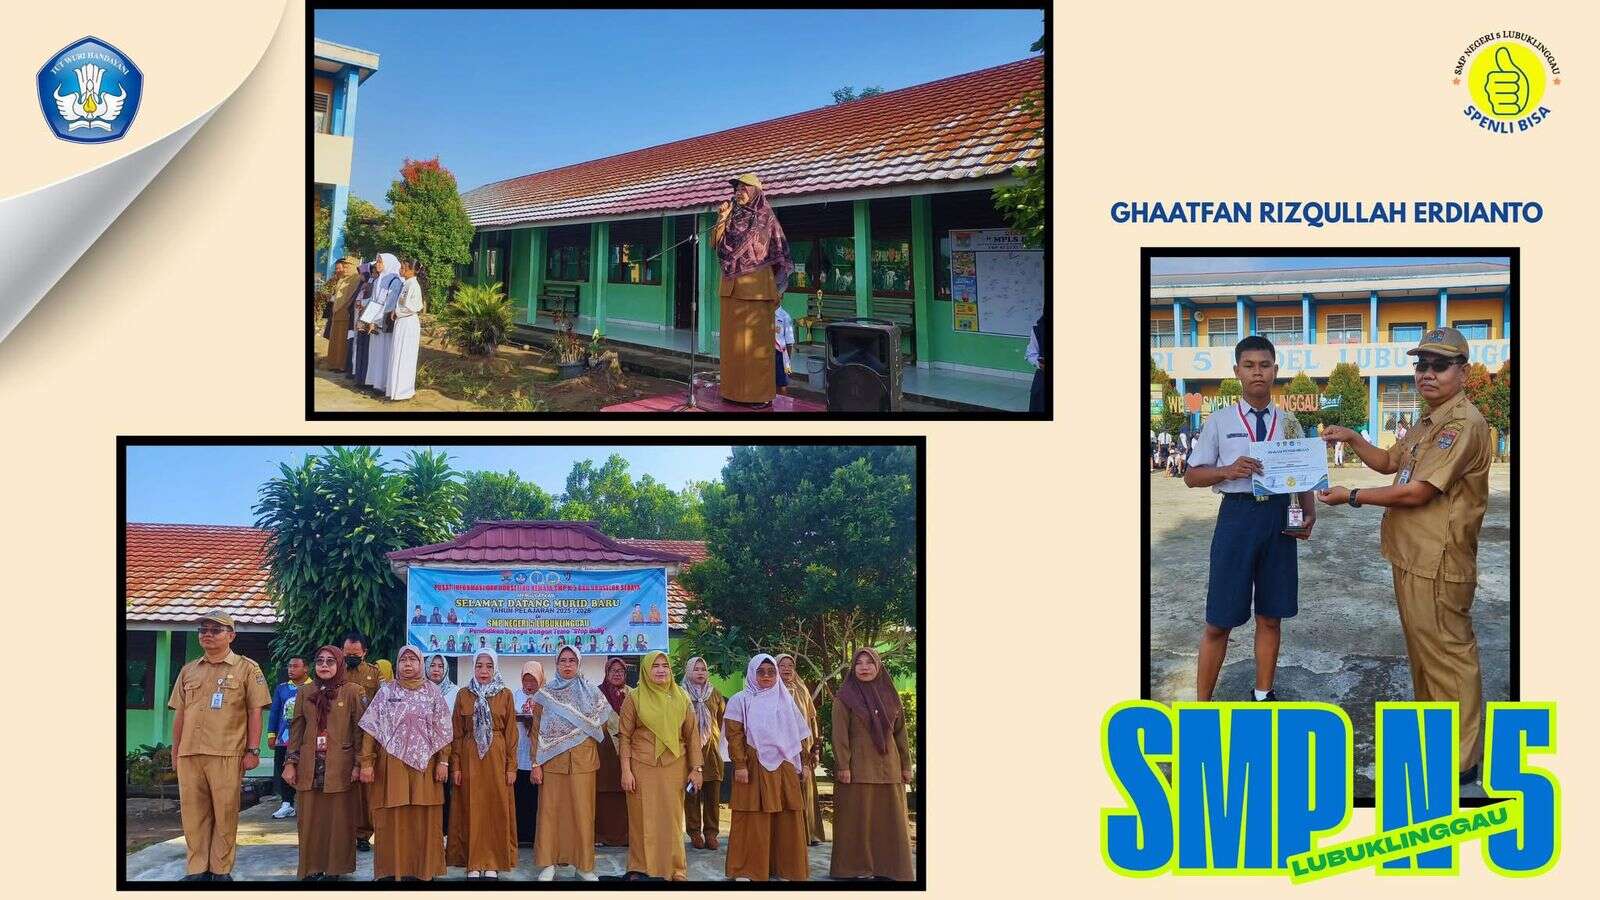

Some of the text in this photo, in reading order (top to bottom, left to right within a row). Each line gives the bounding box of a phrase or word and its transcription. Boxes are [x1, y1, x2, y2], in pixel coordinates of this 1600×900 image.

[1192, 351, 1213, 371] 5
[455, 598, 620, 608] SELAMAT DATANG MURID BARU
[487, 619, 502, 628] SMP
